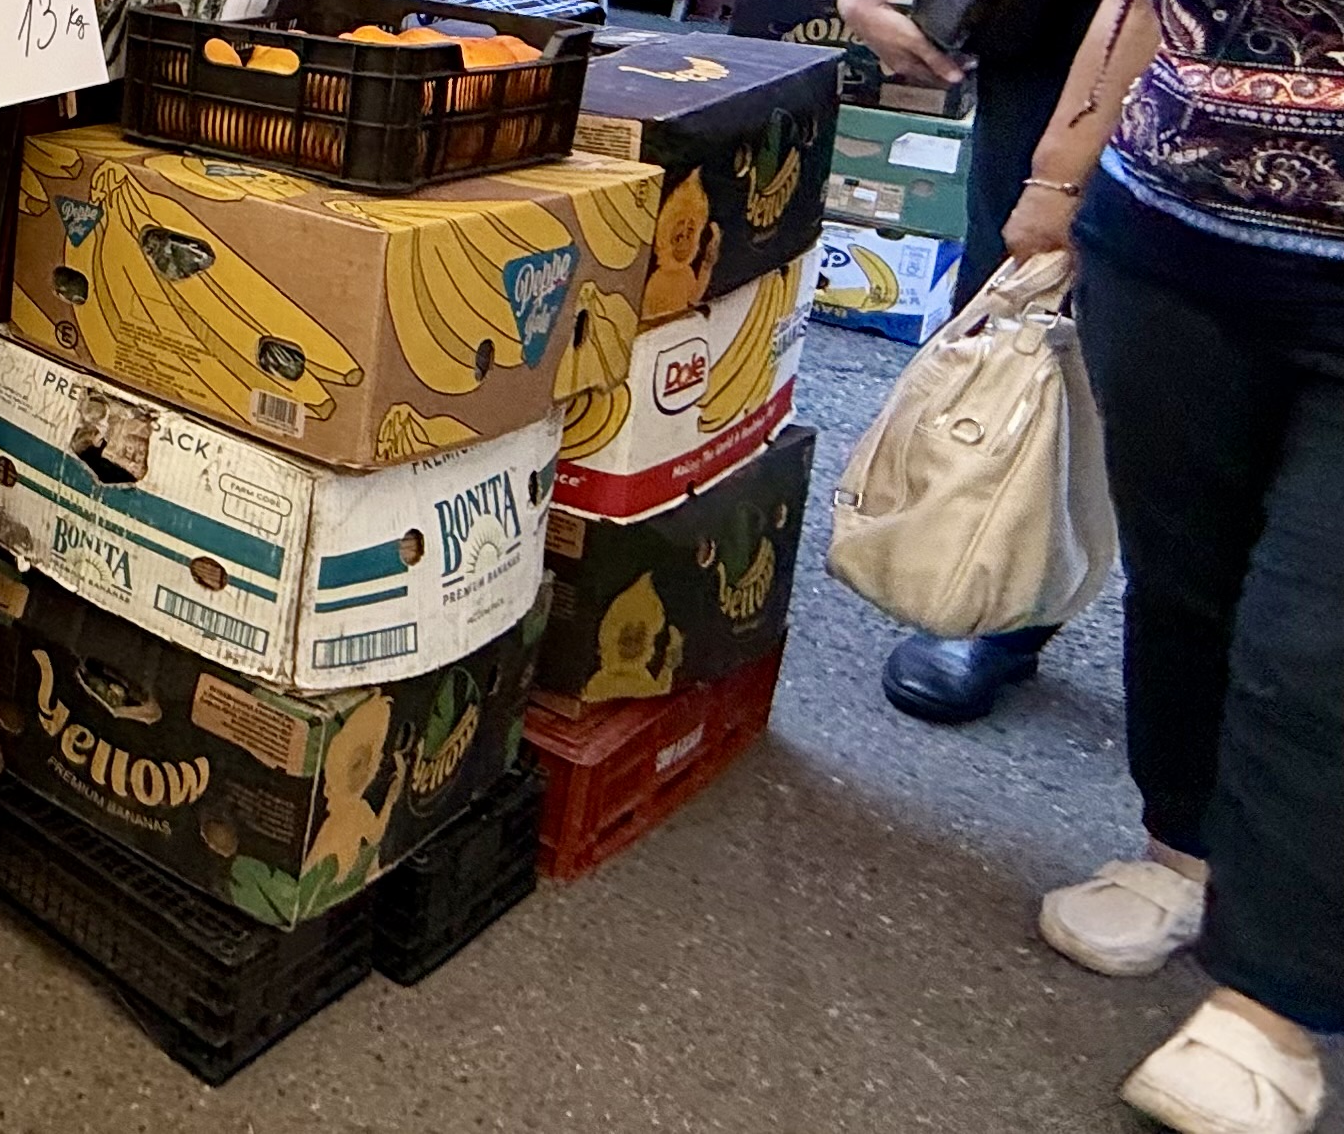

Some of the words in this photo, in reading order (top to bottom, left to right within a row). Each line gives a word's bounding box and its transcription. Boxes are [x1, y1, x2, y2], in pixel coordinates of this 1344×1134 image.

[514, 253, 572, 318] Peppe
[664, 352, 706, 391] Dole
[52, 515, 133, 591] BONITA
[435, 470, 522, 578] BONITA
[48, 755, 105, 809] PREMIUM
[106, 800, 173, 836] BANANAS
